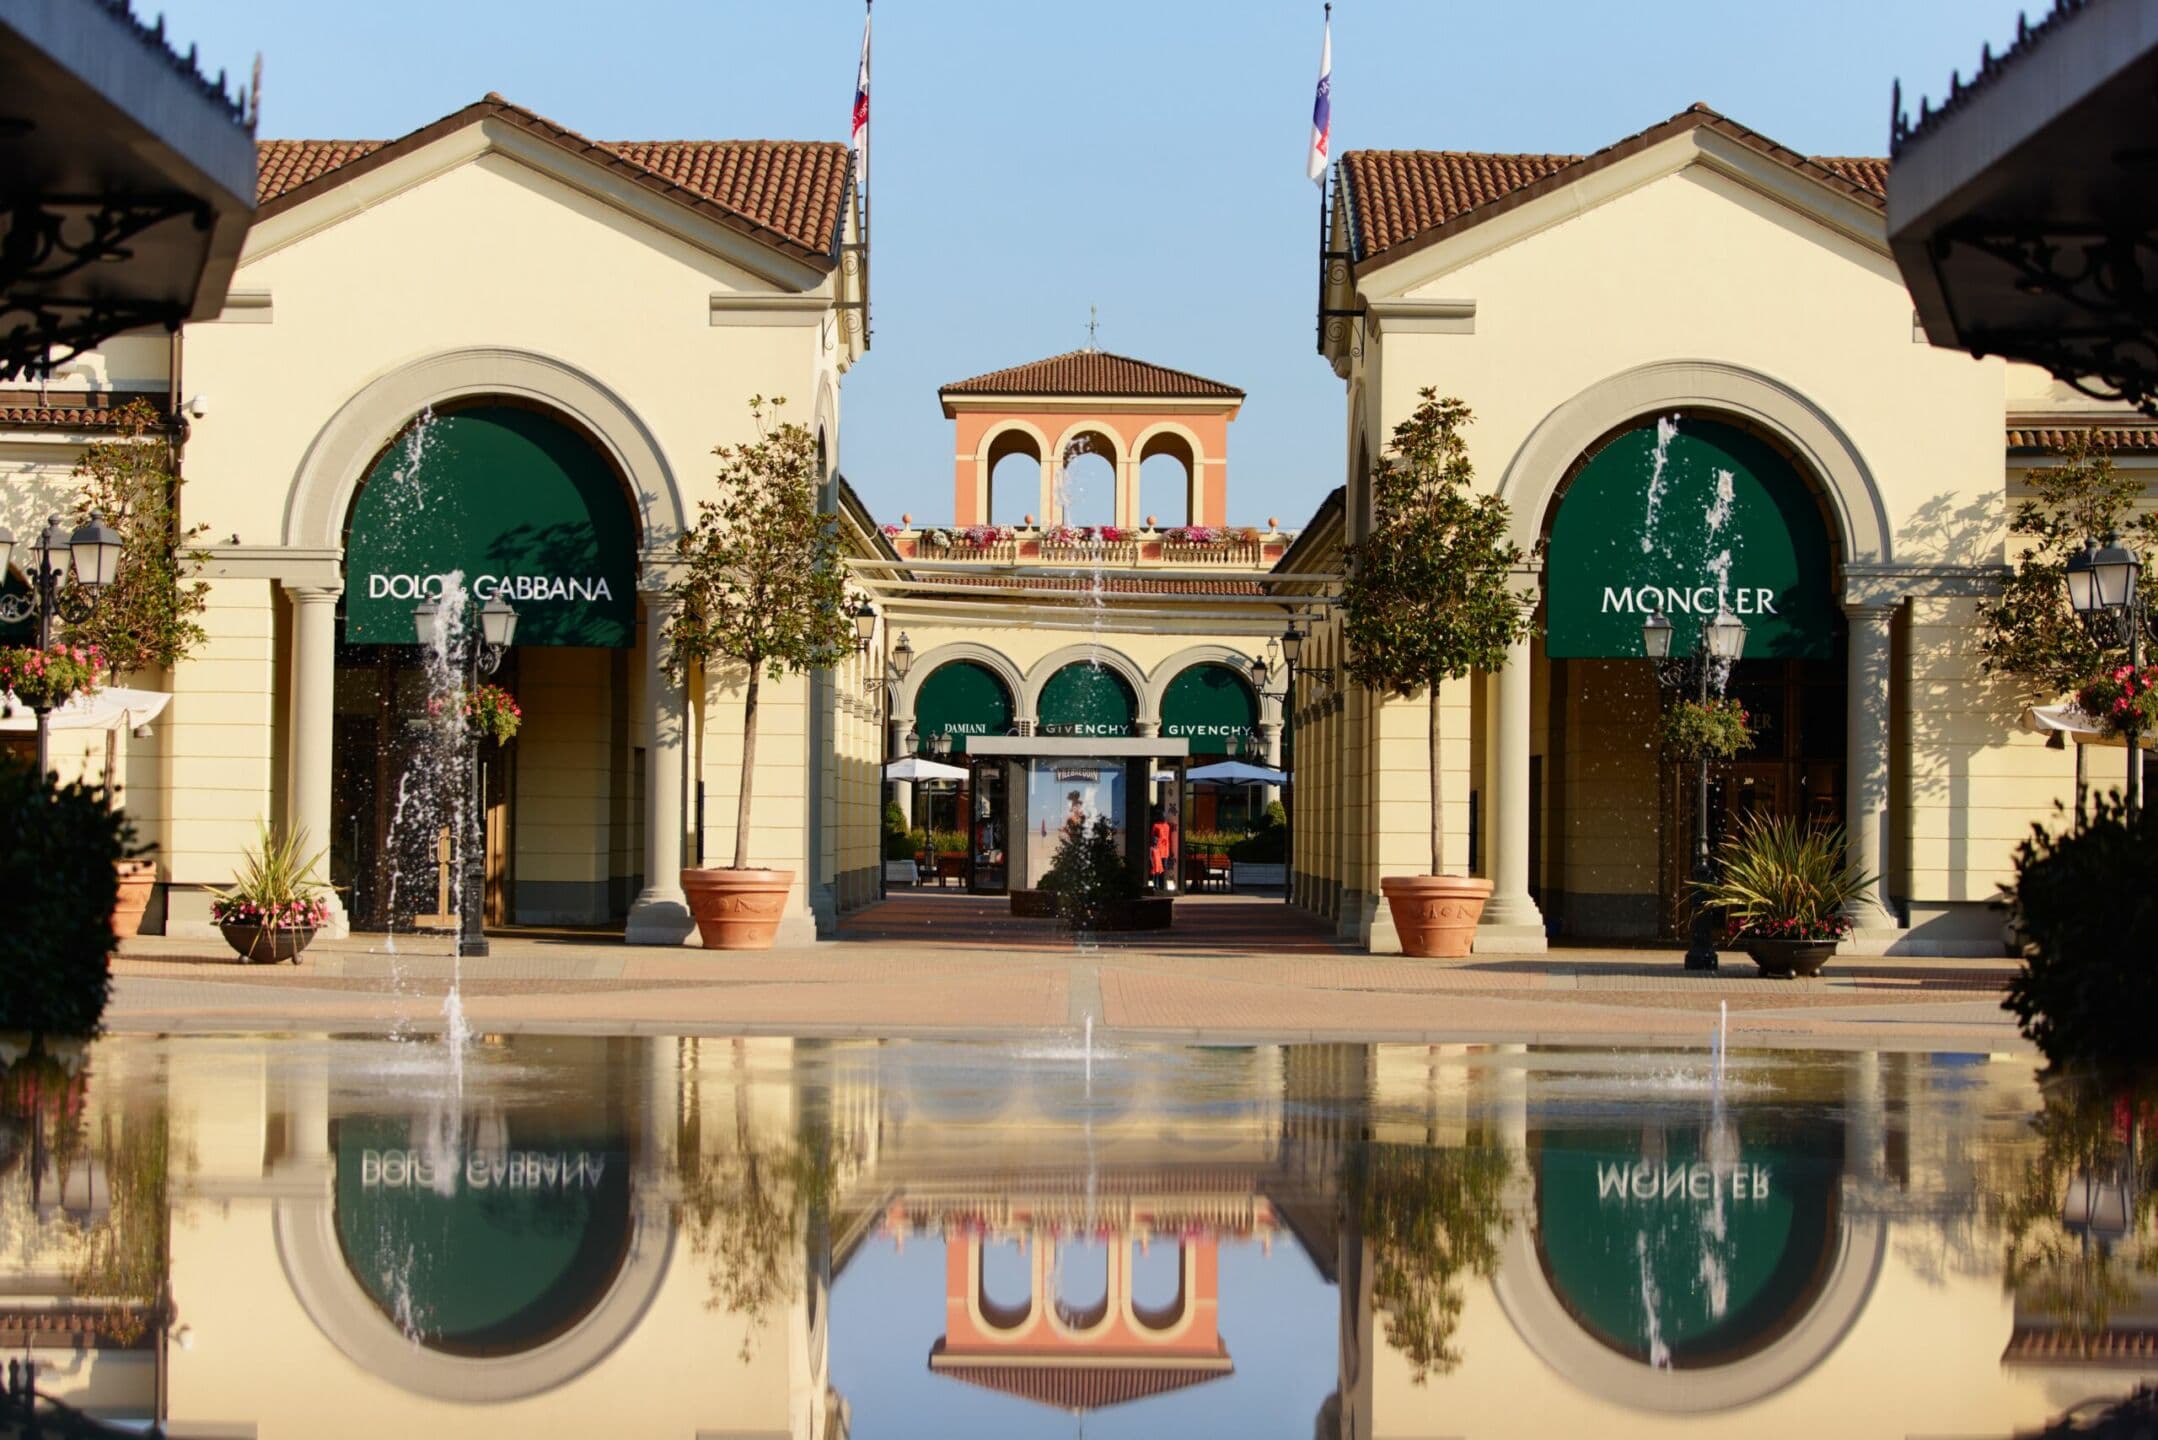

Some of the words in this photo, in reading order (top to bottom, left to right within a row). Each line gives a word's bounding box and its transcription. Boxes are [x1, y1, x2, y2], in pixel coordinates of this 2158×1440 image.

[369, 574, 448, 600] DOLC
[473, 574, 613, 601] GABBANA
[944, 723, 986, 734] DAMIANI
[1046, 723, 1129, 735] GIVENCHY
[1168, 724, 1252, 737] GIVENCHY
